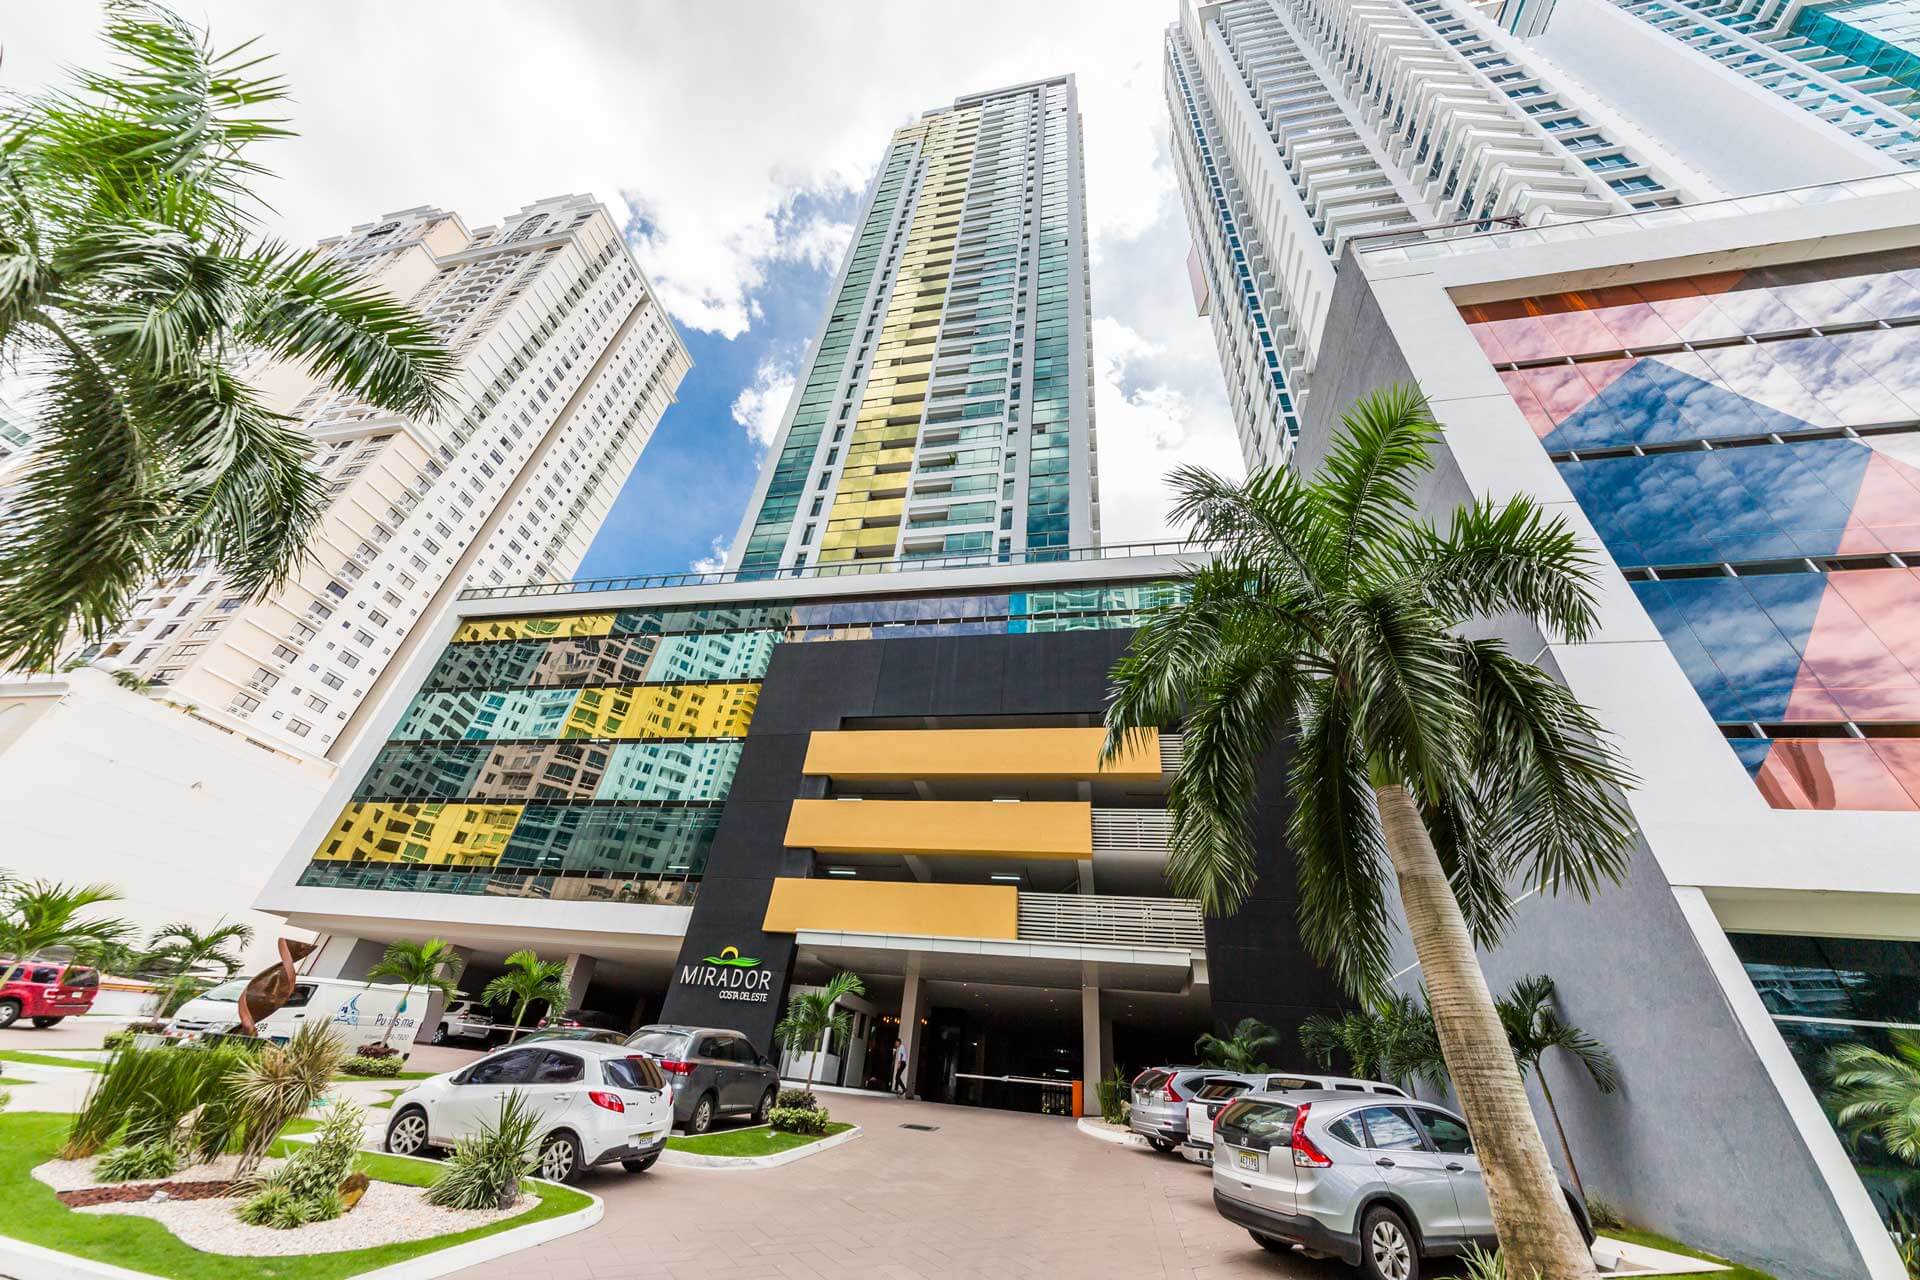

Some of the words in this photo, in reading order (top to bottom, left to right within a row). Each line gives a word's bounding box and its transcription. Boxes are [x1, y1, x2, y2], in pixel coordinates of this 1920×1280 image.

[680, 965, 772, 990] MIRADOR
[719, 990, 739, 1000] COSTA
[739, 991, 751, 1001] DEL
[751, 992, 768, 1002] ESTE
